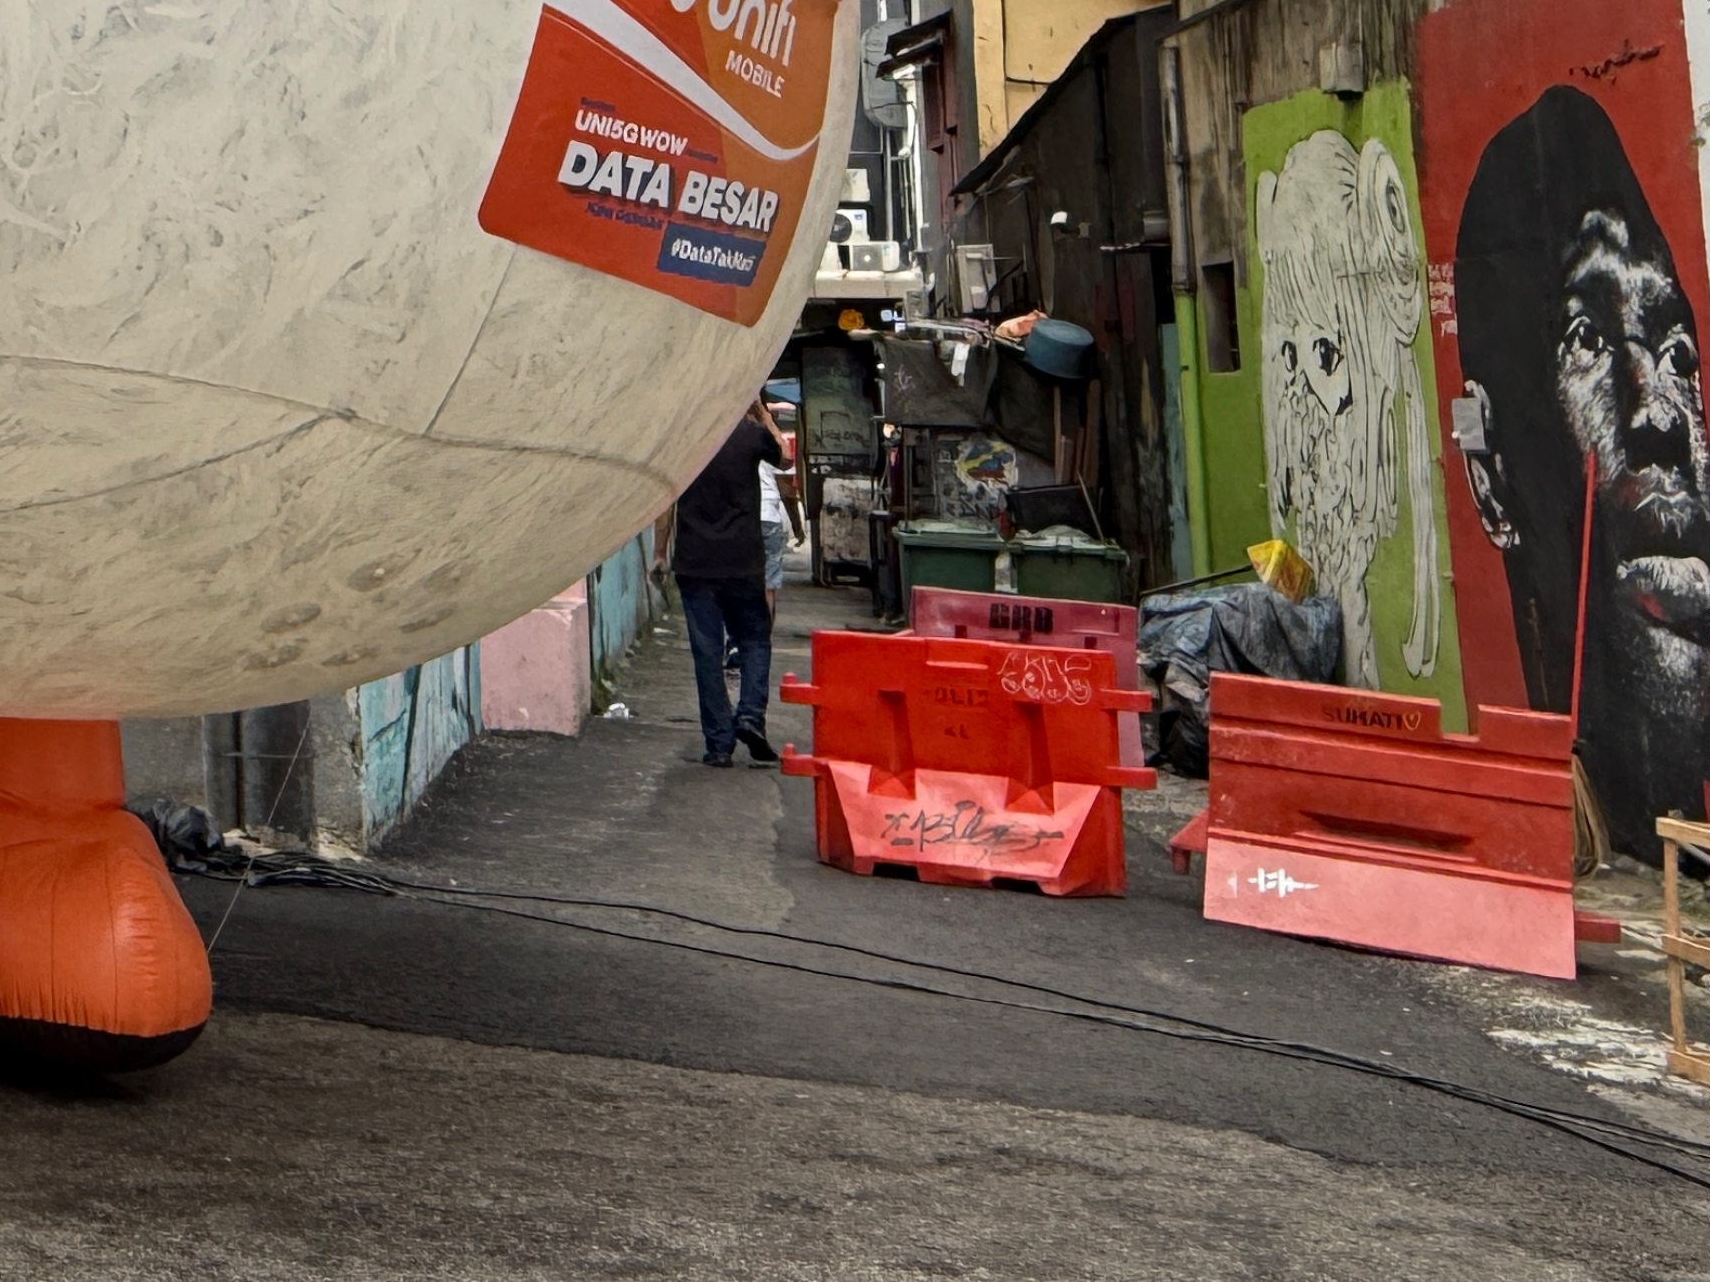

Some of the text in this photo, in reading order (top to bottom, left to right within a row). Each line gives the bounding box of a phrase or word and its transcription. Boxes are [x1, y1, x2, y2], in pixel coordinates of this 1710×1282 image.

[725, 49, 785, 98] MOBILE
[557, 139, 671, 208] DATA
[678, 170, 779, 232] BESAR
